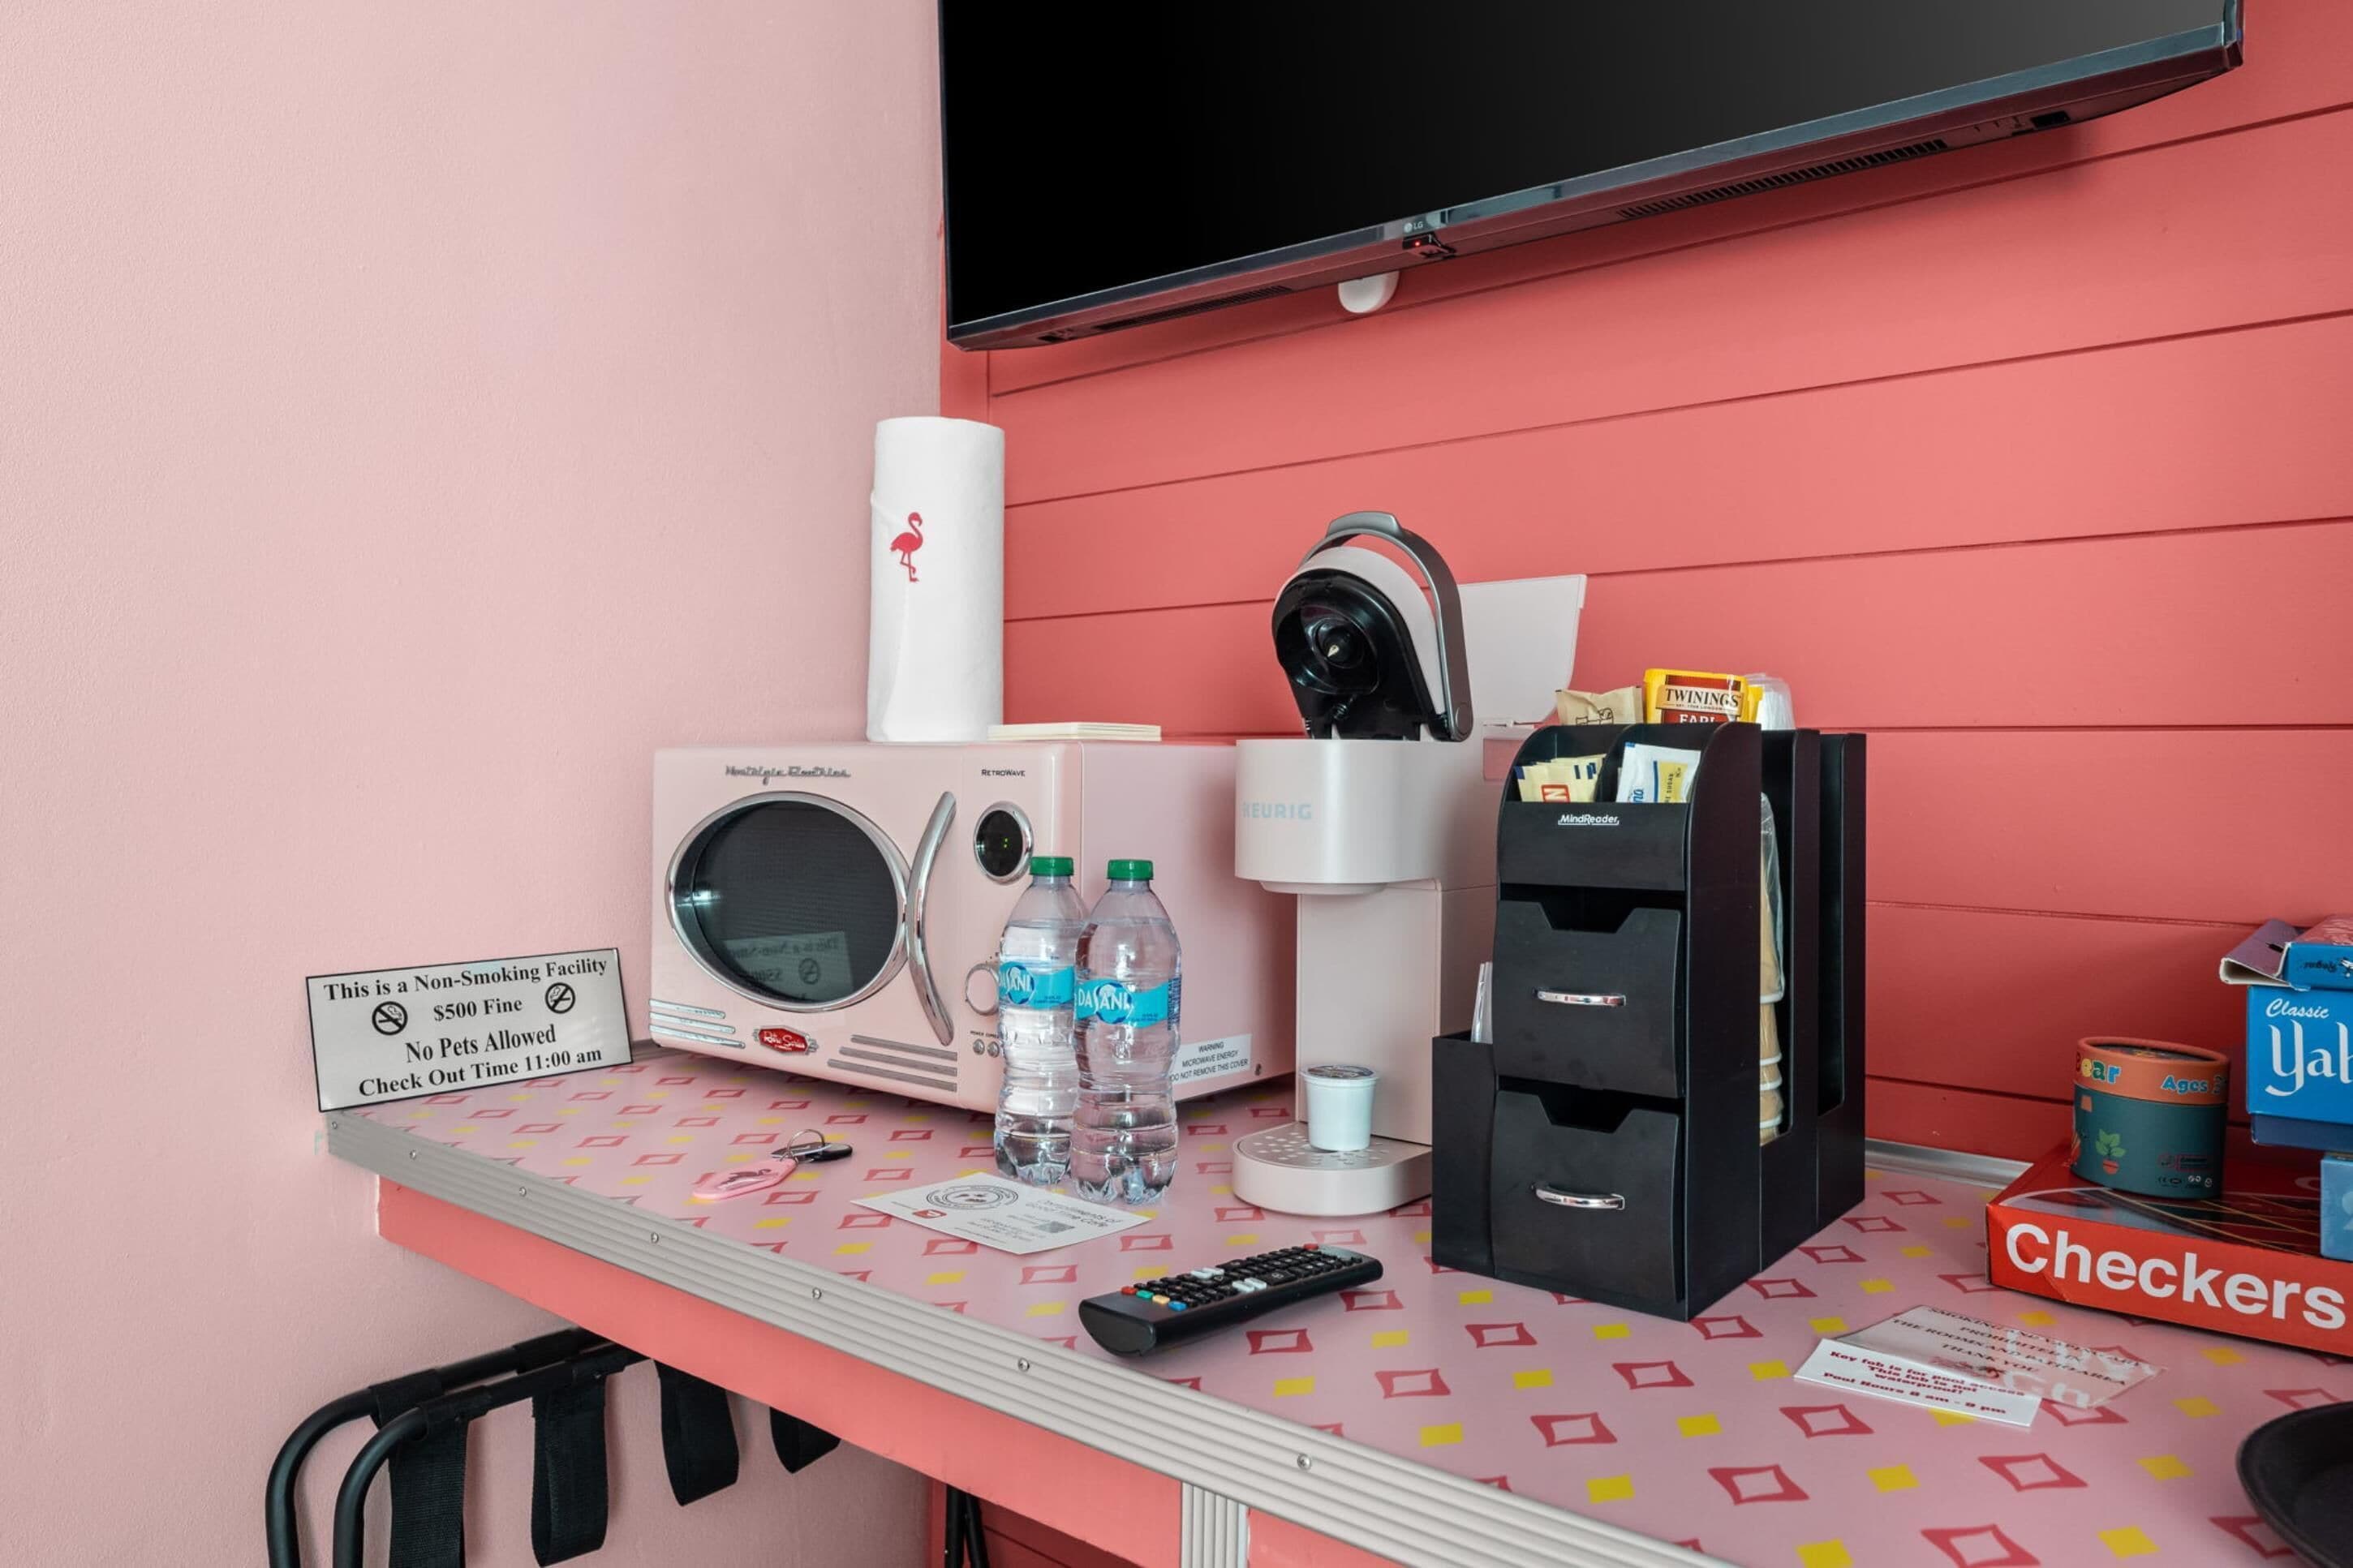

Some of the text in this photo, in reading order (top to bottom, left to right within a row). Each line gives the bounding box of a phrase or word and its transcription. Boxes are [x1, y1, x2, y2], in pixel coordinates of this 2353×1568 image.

[1413, 221, 1423, 230] LG
[1666, 689, 1739, 707] TWININGS
[1241, 802, 1312, 818] KEURIG
[1559, 814, 1619, 825] MindReader
[324, 958, 607, 1000] This is a Non-Smoking Facility
[433, 998, 523, 1021] $500 Fine
[1078, 985, 1130, 1014] DASANI
[2266, 998, 2329, 1018] Classic
[406, 1024, 557, 1063] No Pets Allowed
[1198, 1042, 1224, 1052] WARNING
[1169, 1058, 1248, 1082] DO NOT REMOVE THIS COVER
[1181, 1050, 1239, 1068] MICROWAVE ENERGY
[2076, 1052, 2122, 1085] ear
[359, 1049, 602, 1096] Check Out Time 11:00 am
[2161, 1074, 2209, 1094] Ages
[2006, 1222, 2347, 1330] Checkers
[1929, 1308, 2003, 1330] SMOKING
[1893, 1319, 1921, 1329] THE
[1925, 1328, 1983, 1346] ROOMS
[1985, 1346, 2021, 1355] AND
[1960, 1327, 2061, 1355] PROHIBITED
[1830, 1351, 1856, 1361] Key
[1862, 1359, 1885, 1367] fob
[1932, 1375, 1965, 1384] pool
[1942, 1344, 2039, 1371] THANK YOU
[1824, 1373, 1856, 1382] Pool
[1860, 1381, 1904, 1393] Hours
[1868, 1366, 1900, 1377] This
[1905, 1374, 1929, 1382] fob
